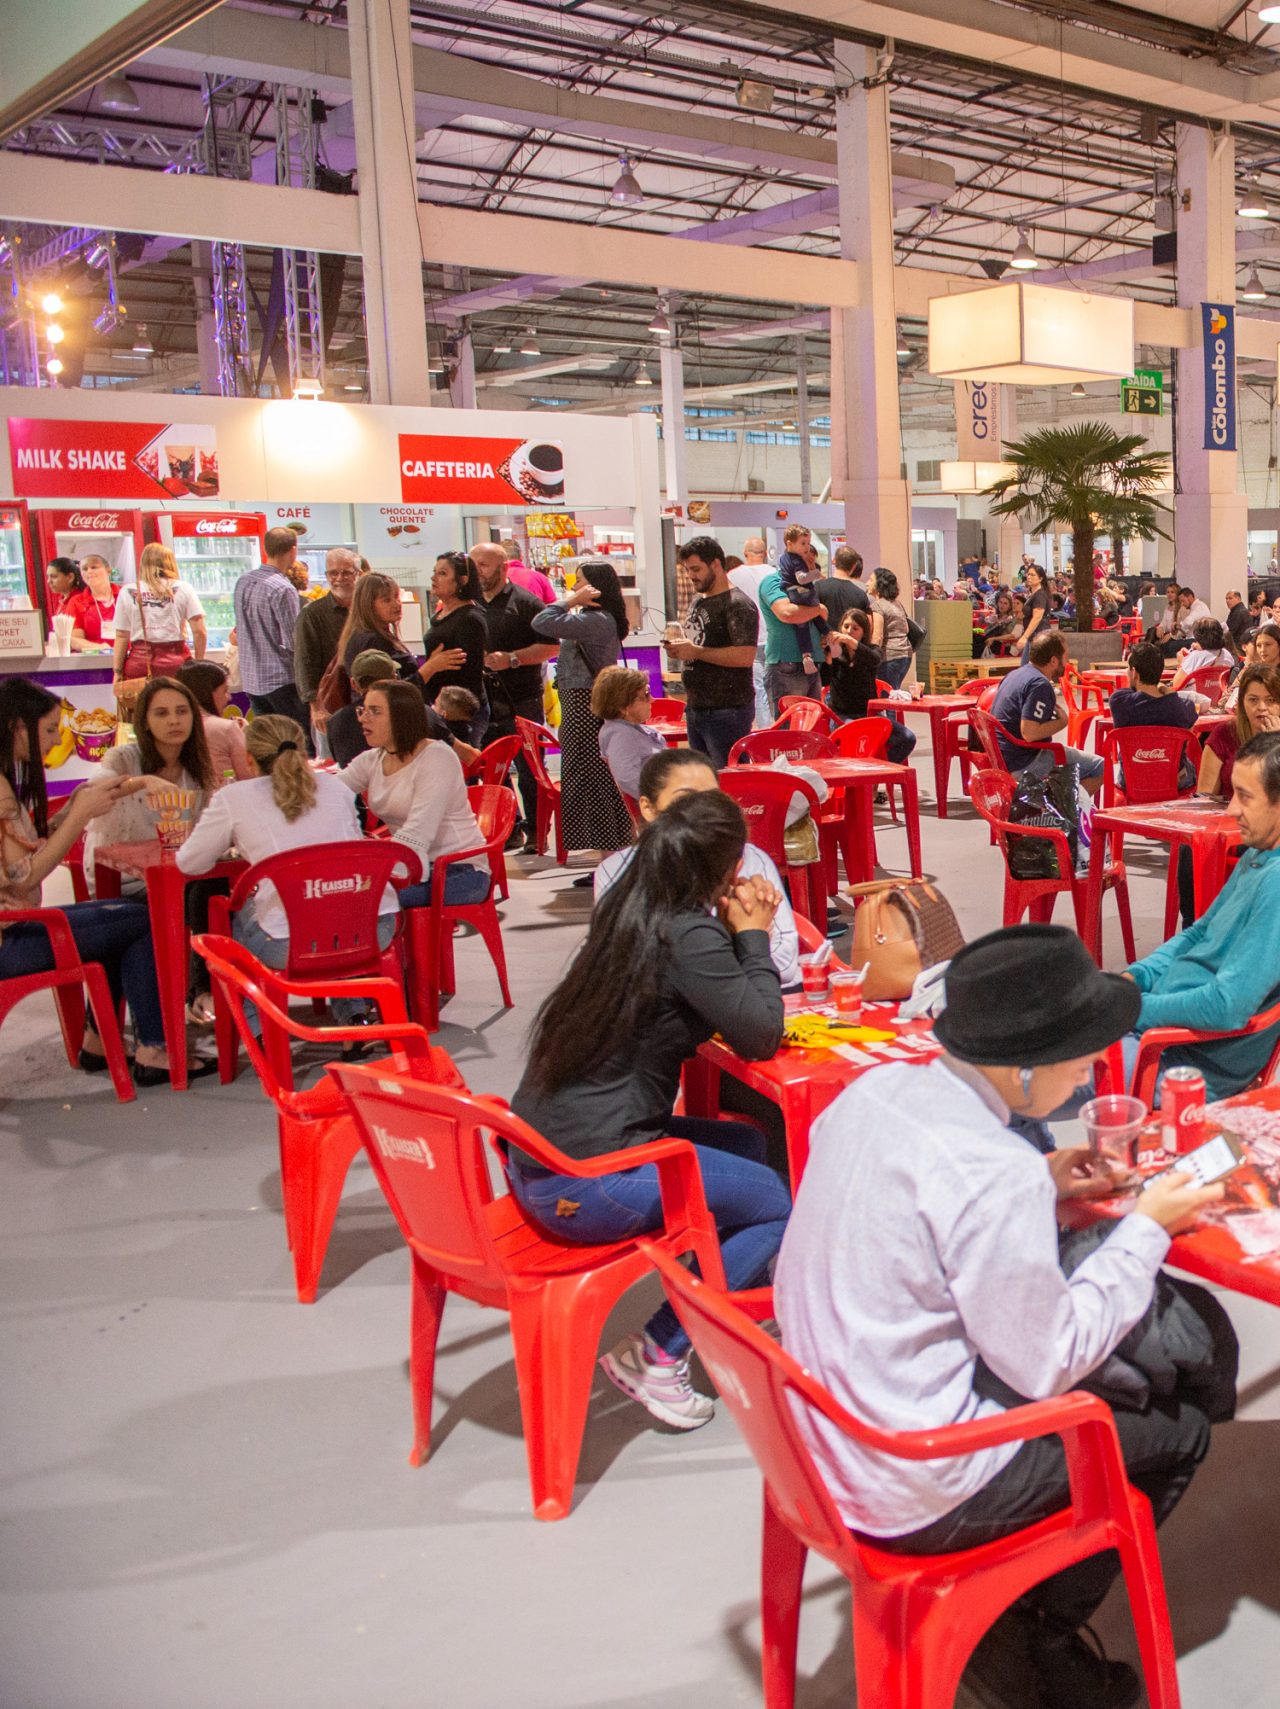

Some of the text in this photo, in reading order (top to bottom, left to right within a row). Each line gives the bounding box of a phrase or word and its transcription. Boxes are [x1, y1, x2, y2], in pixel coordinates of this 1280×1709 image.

[1126, 375, 1156, 387] SAÍDA
[1212, 339, 1227, 445] Colombo
[17, 448, 127, 470] MILK SHAKE
[402, 460, 495, 479] CAFETERIA
[277, 506, 311, 518] CAFÉ
[380, 507, 434, 516] CHOCOLATE
[68, 512, 119, 529] Coca-Cola
[196, 519, 237, 533] Coca-Cola
[389, 515, 426, 523] QUENTE
[1033, 701, 1046, 719] 5
[1134, 748, 1166, 759] Coca-Cola
